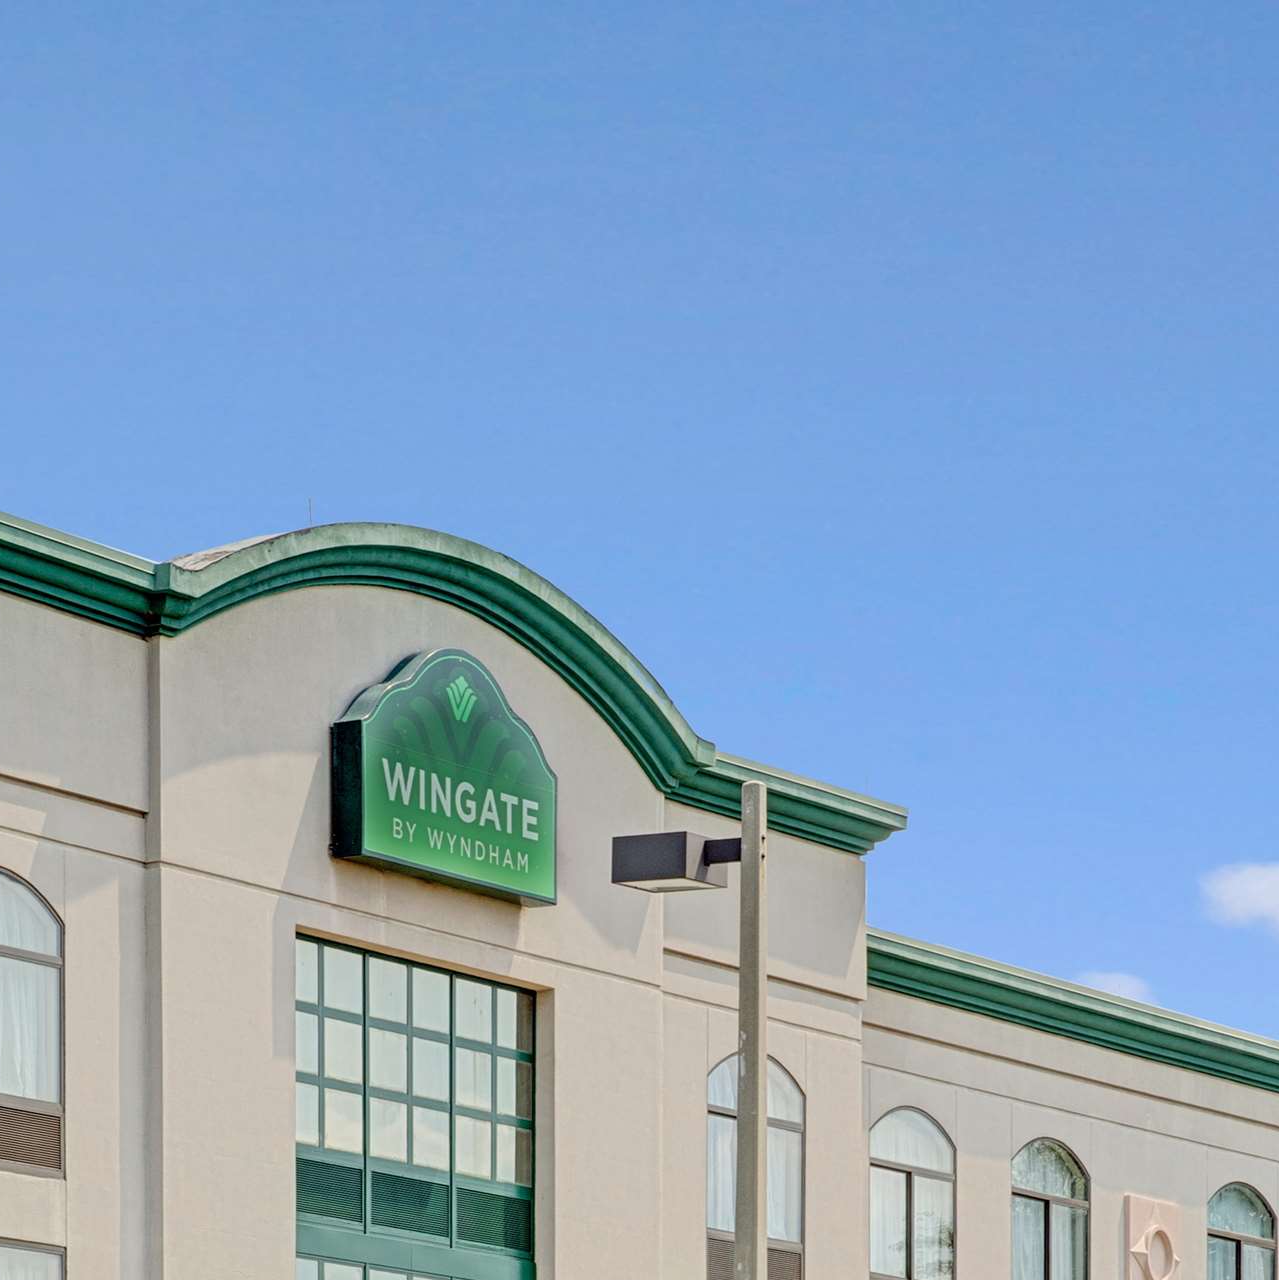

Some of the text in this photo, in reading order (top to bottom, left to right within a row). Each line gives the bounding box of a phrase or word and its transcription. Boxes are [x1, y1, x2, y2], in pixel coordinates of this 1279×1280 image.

[381, 757, 539, 842] WINGATE
[392, 817, 529, 873] BY WYNDHAM
